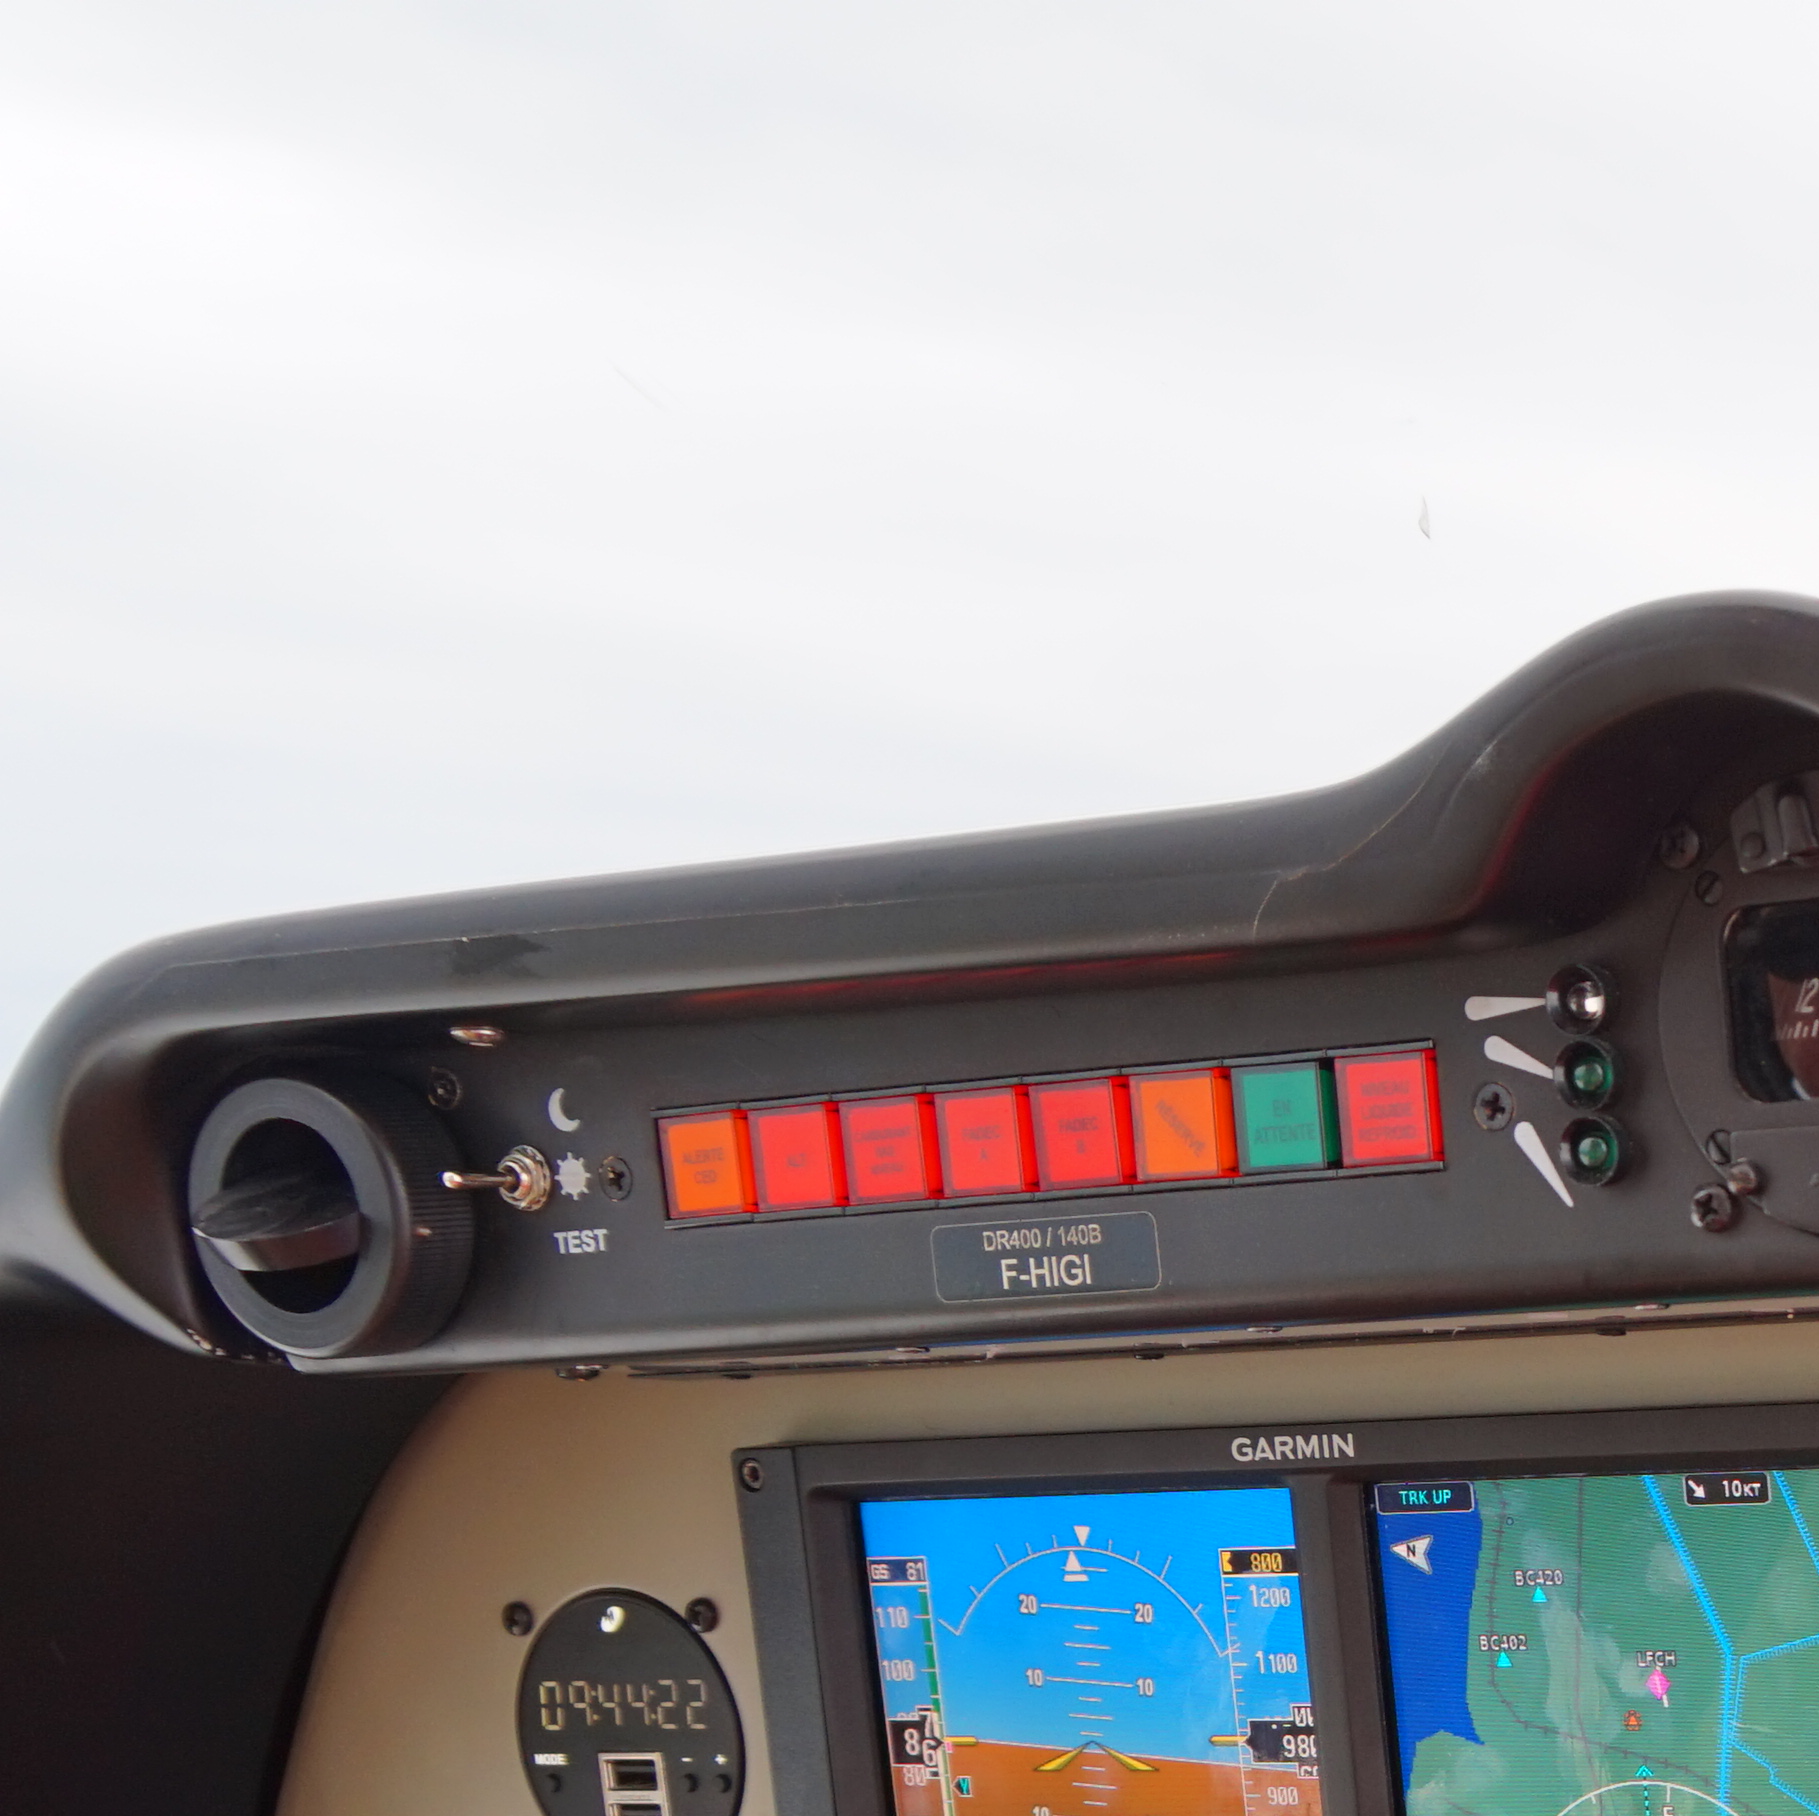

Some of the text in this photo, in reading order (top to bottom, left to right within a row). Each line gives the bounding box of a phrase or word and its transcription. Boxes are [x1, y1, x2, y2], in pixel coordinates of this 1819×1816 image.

[554, 1230, 608, 1254] TEST
[983, 1229, 1041, 1251] DR400
[1057, 1225, 1101, 1246] 140B
[1000, 1254, 1092, 1289] F-HIGI
[1231, 1433, 1356, 1461] GARMIN
[1399, 1488, 1452, 1507] TRK UP
[1515, 1569, 1563, 1586] BC420
